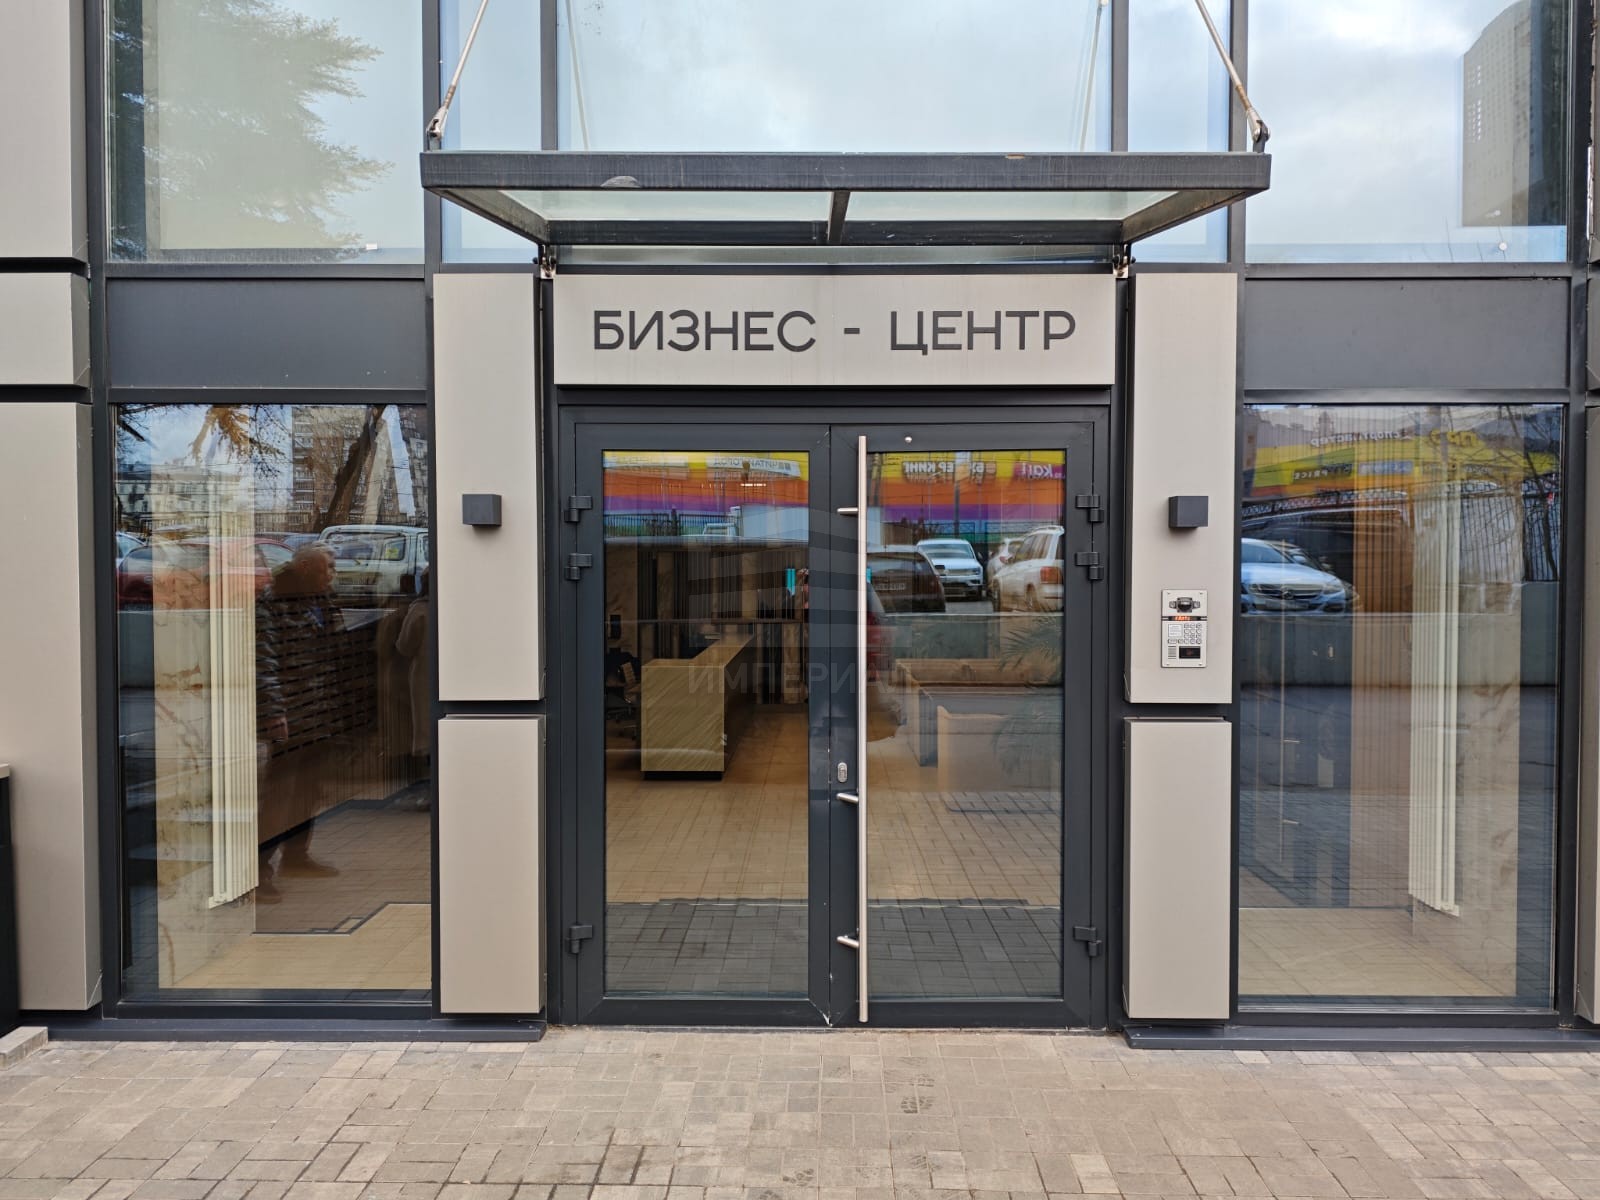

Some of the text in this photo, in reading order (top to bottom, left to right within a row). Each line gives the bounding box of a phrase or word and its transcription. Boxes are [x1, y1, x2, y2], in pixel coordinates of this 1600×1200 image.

[594, 309, 1076, 355] БИЗНЕС - ЦЕНТР
